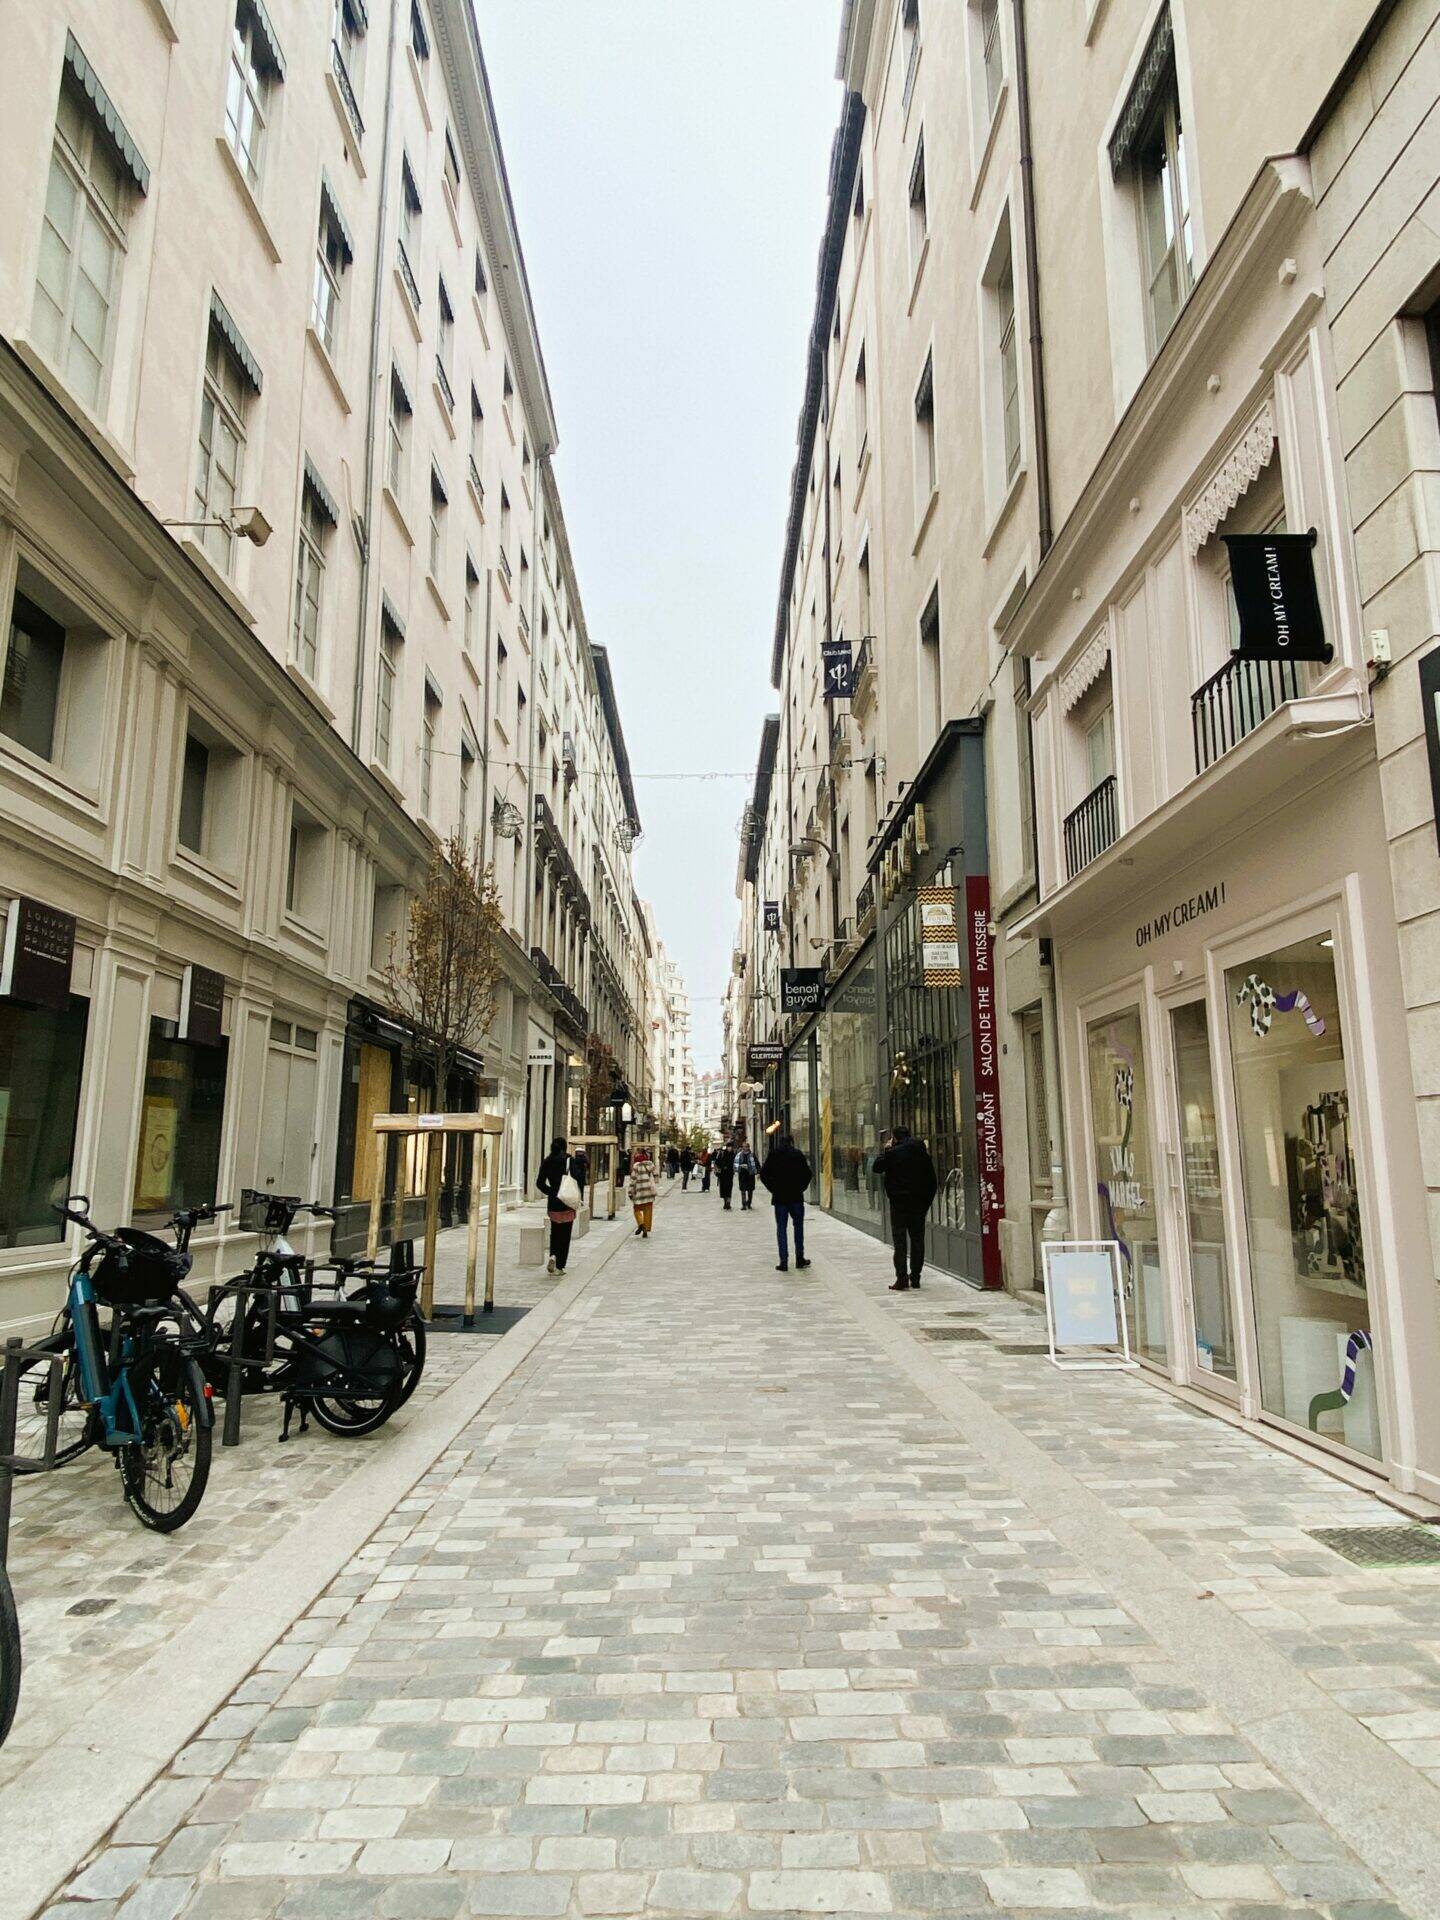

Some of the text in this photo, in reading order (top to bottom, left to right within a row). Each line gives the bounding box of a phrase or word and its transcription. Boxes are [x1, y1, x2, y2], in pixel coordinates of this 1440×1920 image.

[1264, 552, 1284, 600] CREAM
[1271, 602, 1287, 621] MY
[1277, 624, 1290, 646] OH
[1135, 923, 1152, 948] OH
[1154, 911, 1171, 939] MY
[1173, 886, 1219, 927] CREAM
[26, 921, 69, 944] BANQUE
[974, 909, 989, 971] PATISSERIE
[785, 982, 820, 994] benoit
[977, 986, 990, 1009] THE
[786, 994, 818, 1007] guyot
[979, 1013, 991, 1030] DE
[980, 1033, 994, 1077] SALON
[982, 1092, 999, 1173] RESTAURANT
[1109, 1145, 1135, 1178] XMAS
